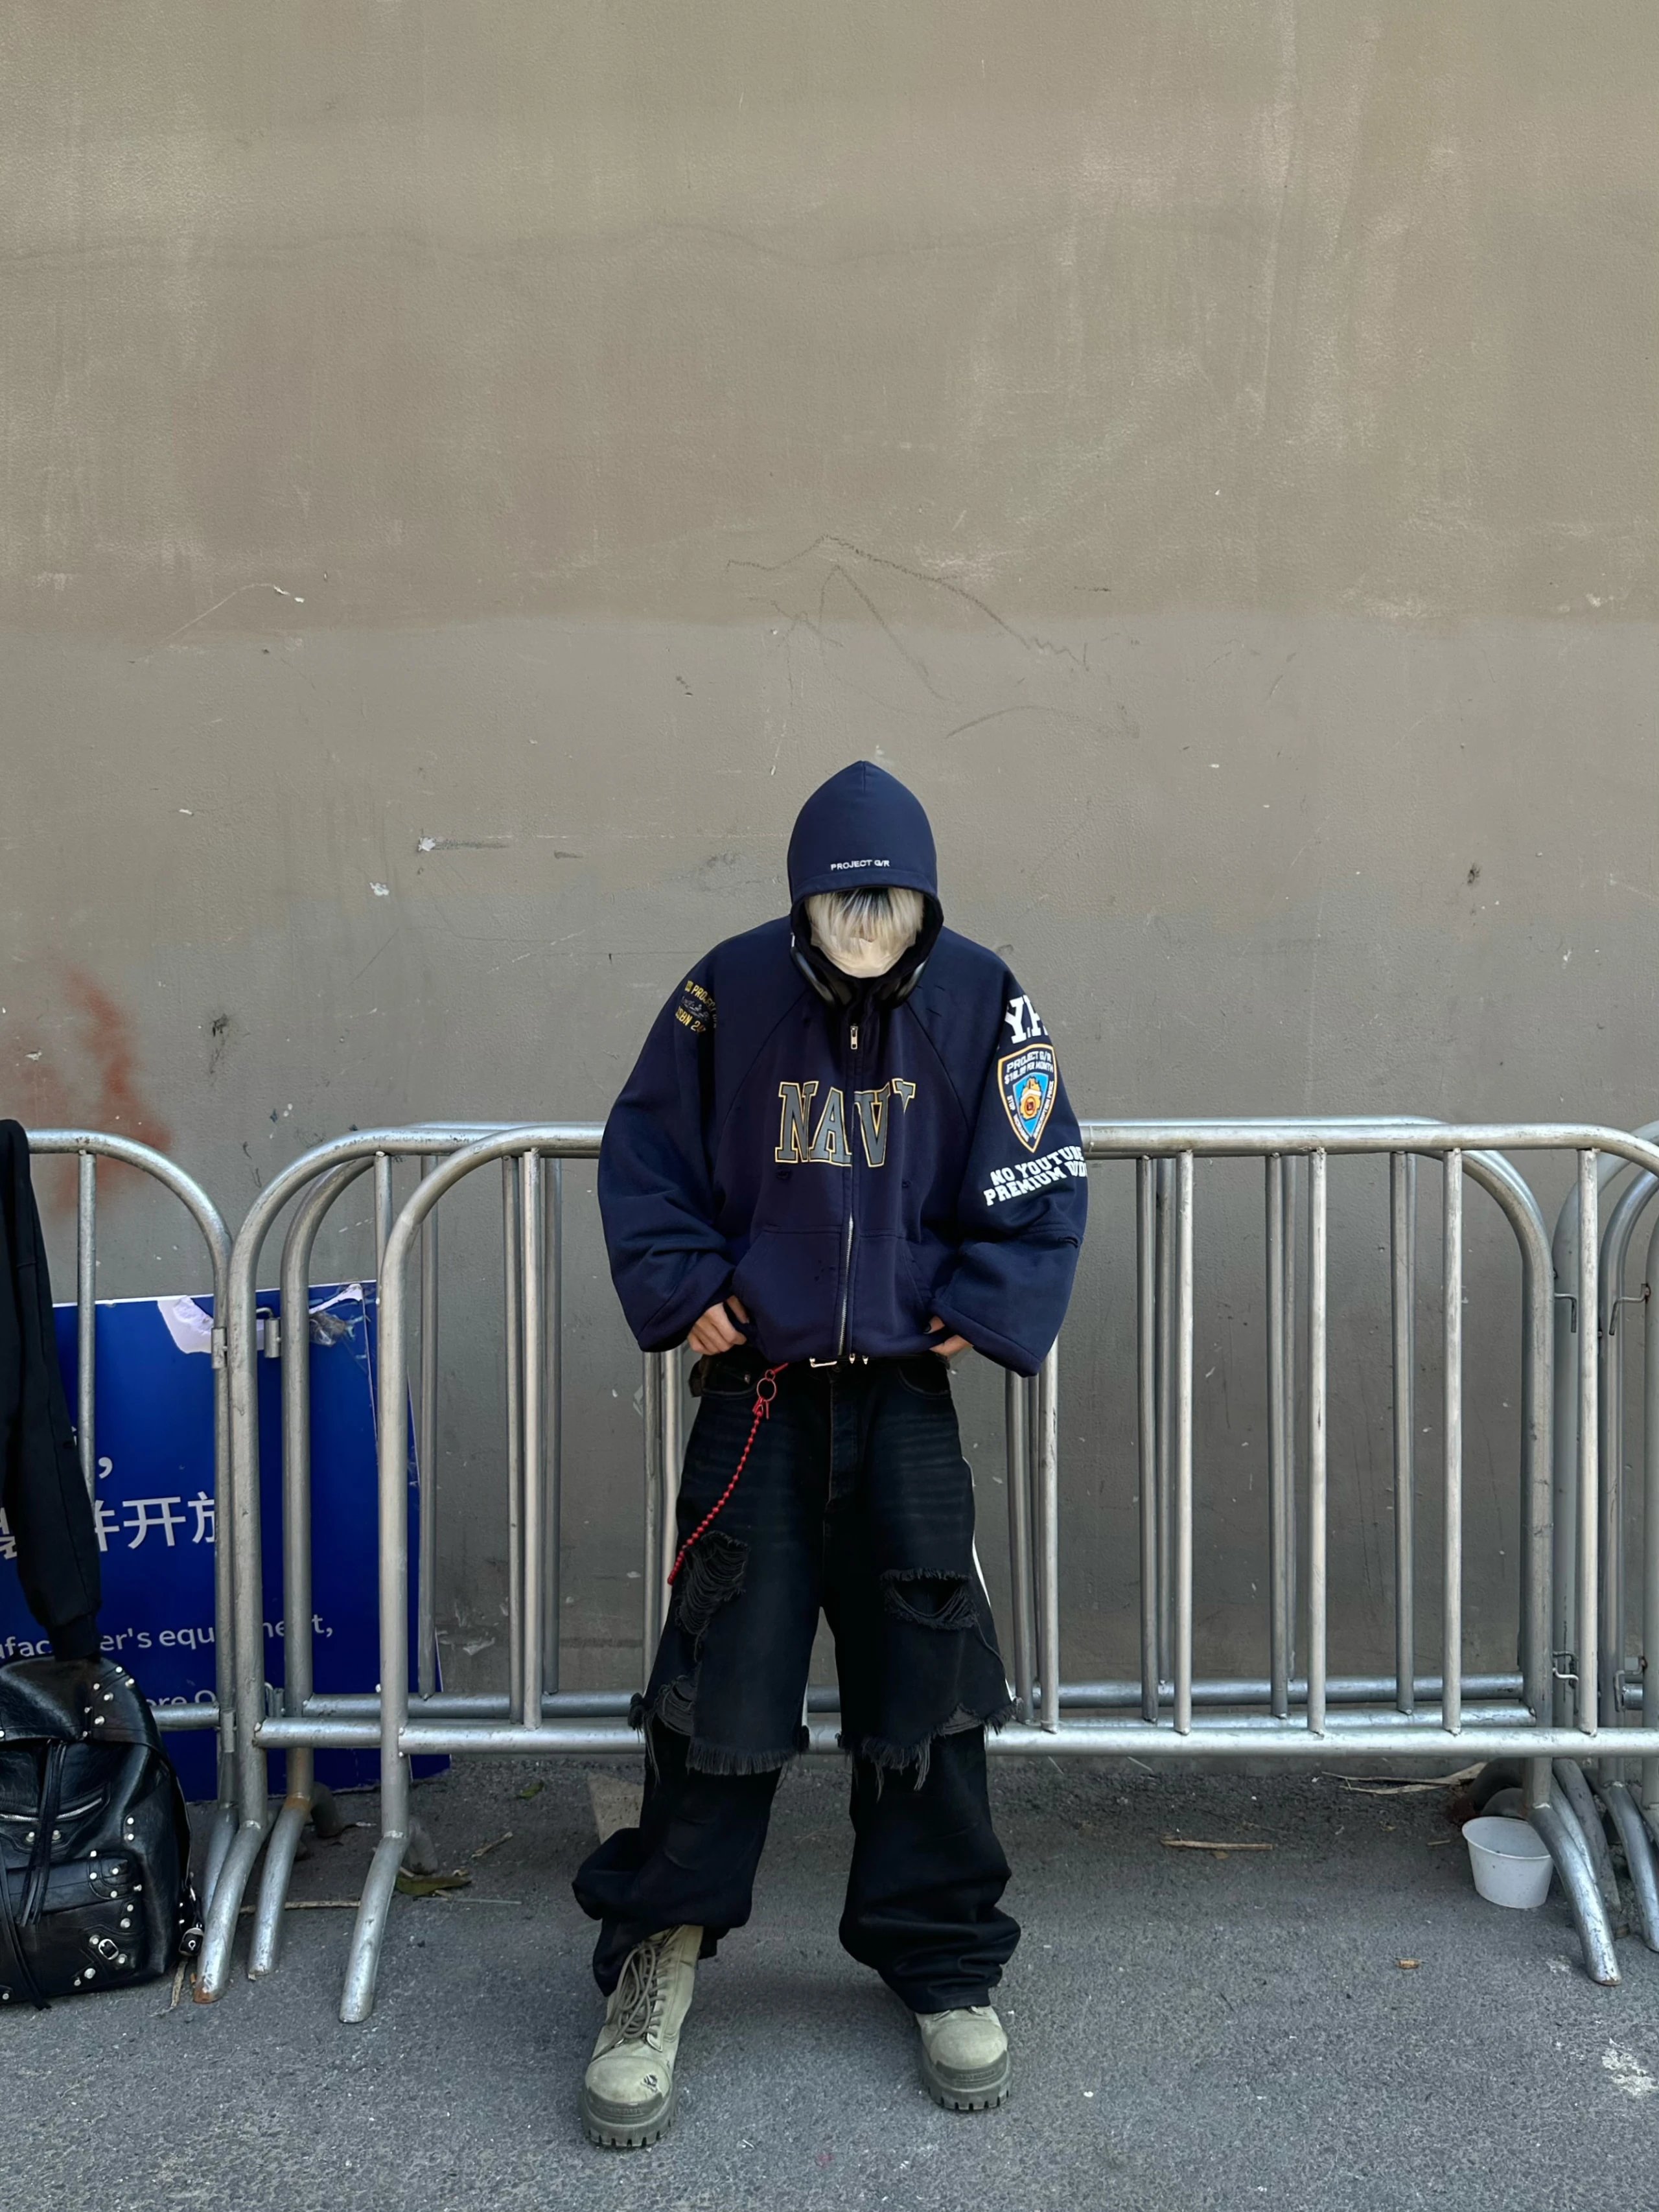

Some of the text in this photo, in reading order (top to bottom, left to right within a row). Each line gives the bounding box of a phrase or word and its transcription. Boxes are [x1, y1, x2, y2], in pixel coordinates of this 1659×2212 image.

[830, 859, 872, 870] PROJECT
[1006, 1051, 1039, 1073] PROJECT
[983, 1167, 1067, 1206] PREMIUM
[990, 1167, 1015, 1186] NO
